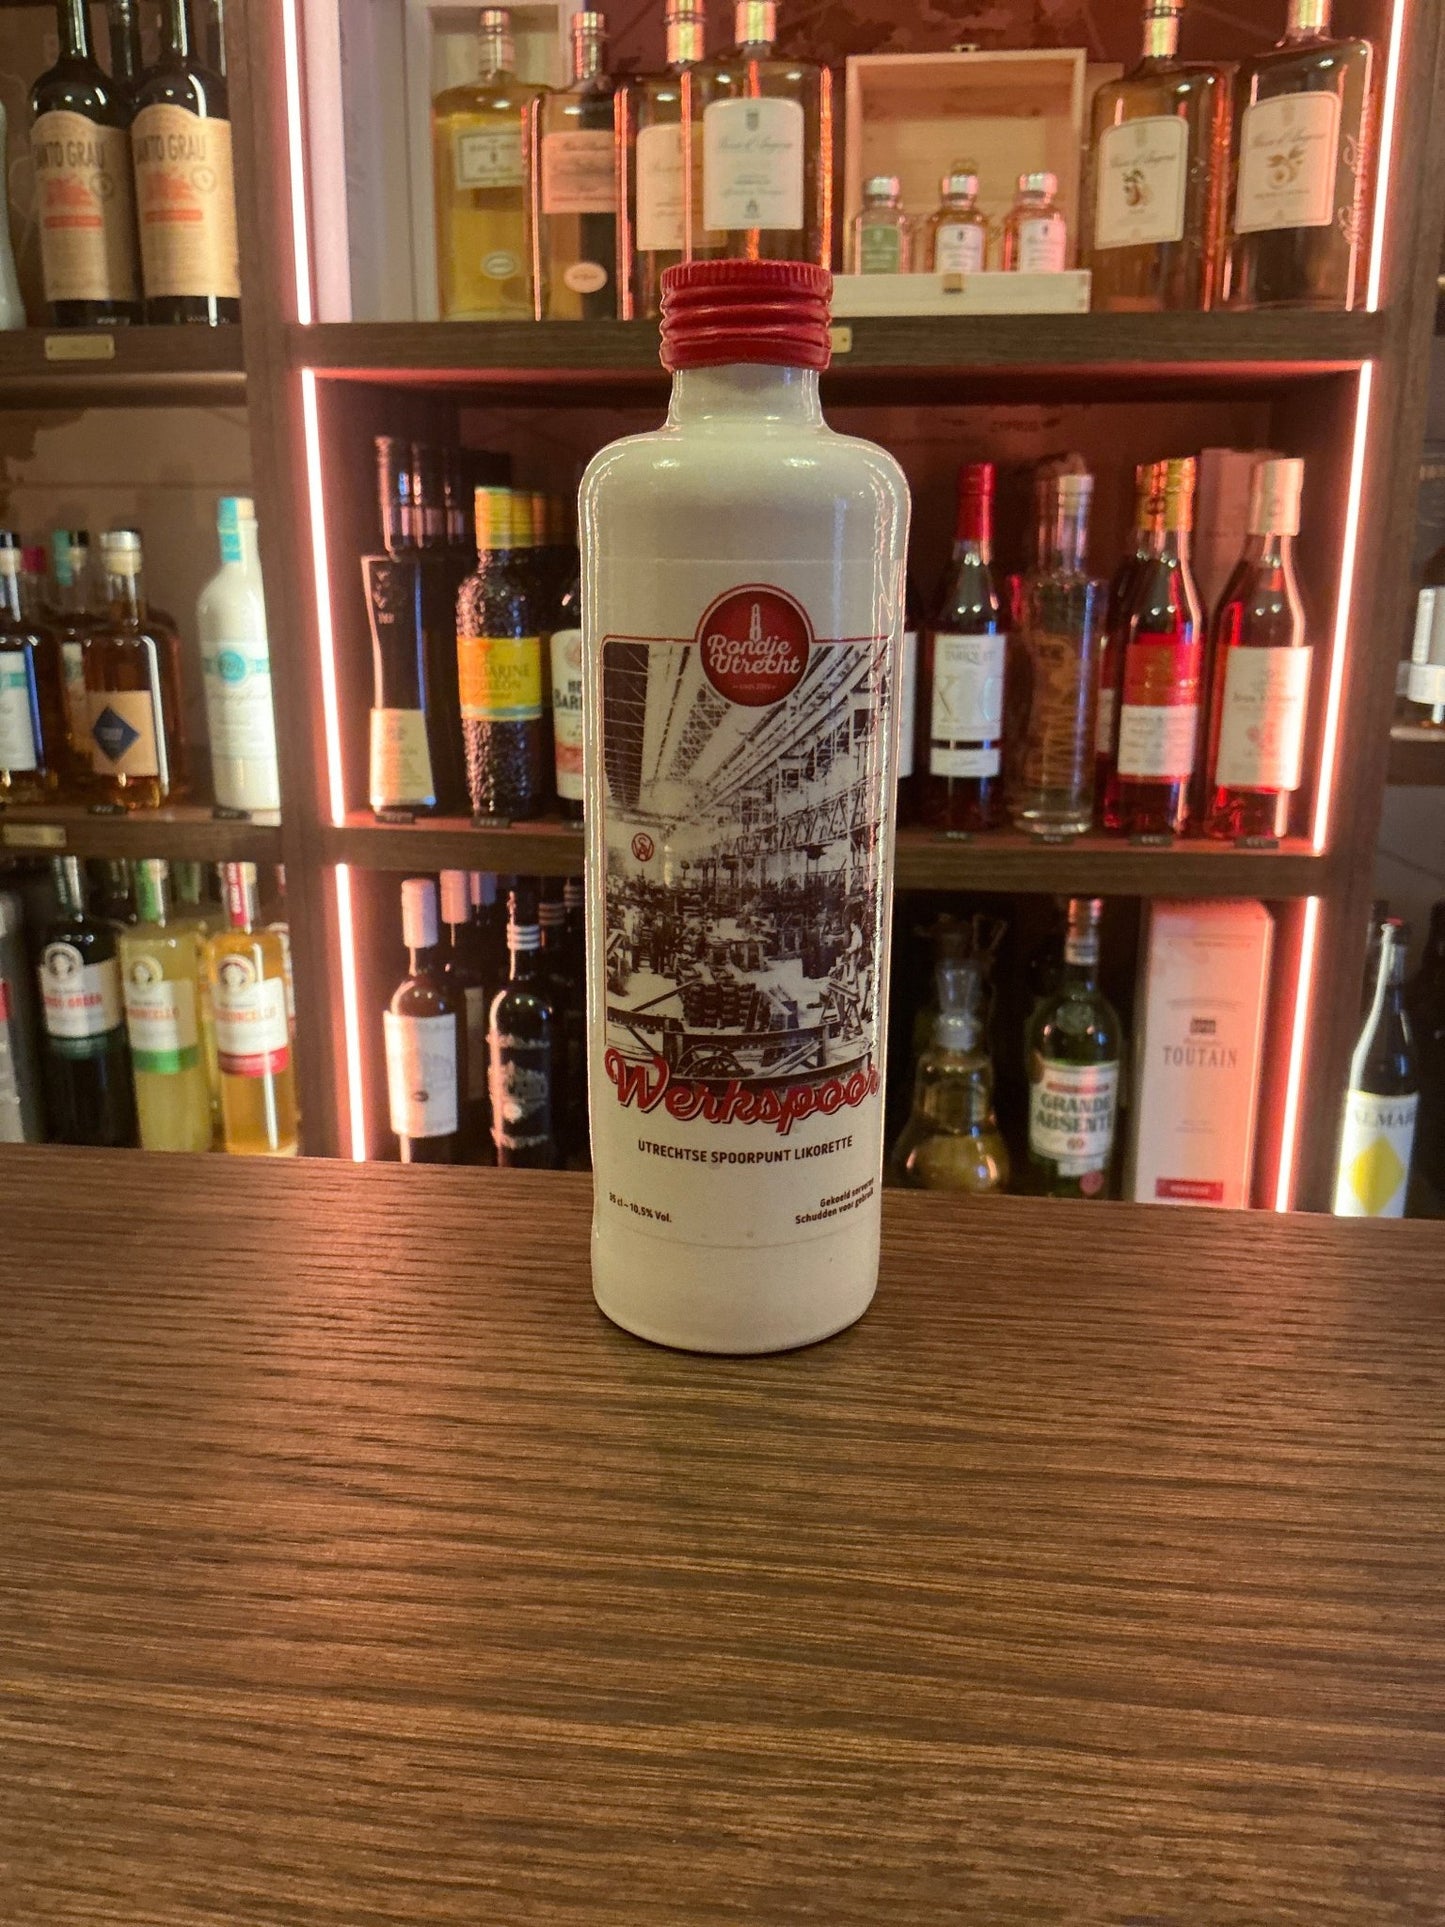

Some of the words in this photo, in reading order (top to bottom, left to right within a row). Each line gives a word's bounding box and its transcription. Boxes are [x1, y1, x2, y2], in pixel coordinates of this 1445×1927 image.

[707, 634, 792, 660] Rondje
[709, 652, 801, 674] Utrecht
[1162, 1045, 1238, 1069] TOUTAIN
[638, 1139, 707, 1163] UTRECHTSE
[710, 1149, 791, 1164] SPOORPUNT
[794, 1135, 853, 1160] LIKORETTE
[820, 1190, 851, 1207] Gekoeld
[655, 1210, 673, 1223] Vol.
[795, 1209, 838, 1225] Schudden
